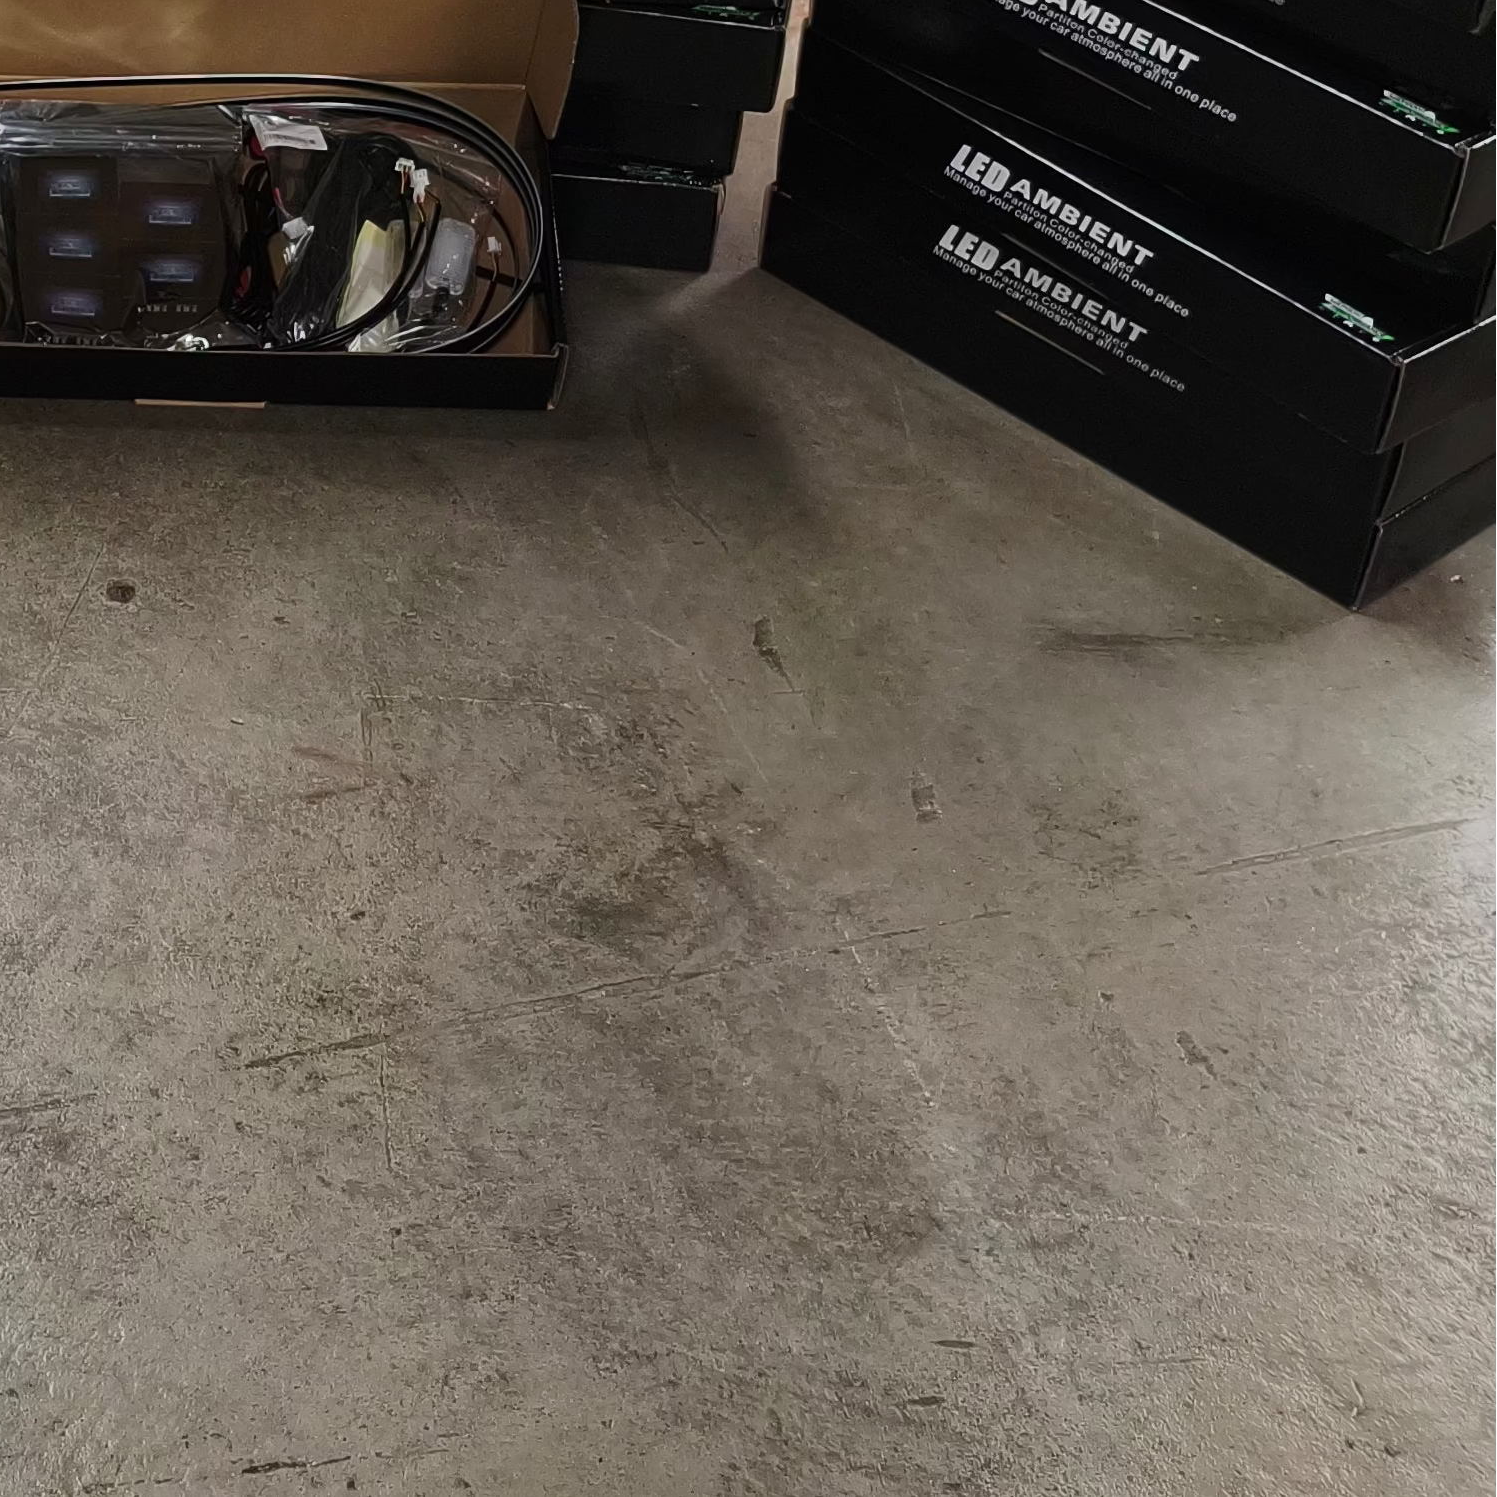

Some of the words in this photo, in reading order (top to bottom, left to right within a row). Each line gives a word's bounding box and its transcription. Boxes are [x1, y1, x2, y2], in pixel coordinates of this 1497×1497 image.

[1087, 29, 1179, 81] Color-changed
[949, 143, 1010, 192] LED
[1009, 178, 1154, 267] AMBIENT
[938, 223, 999, 271] LED
[999, 257, 1148, 343] AMBIENT
